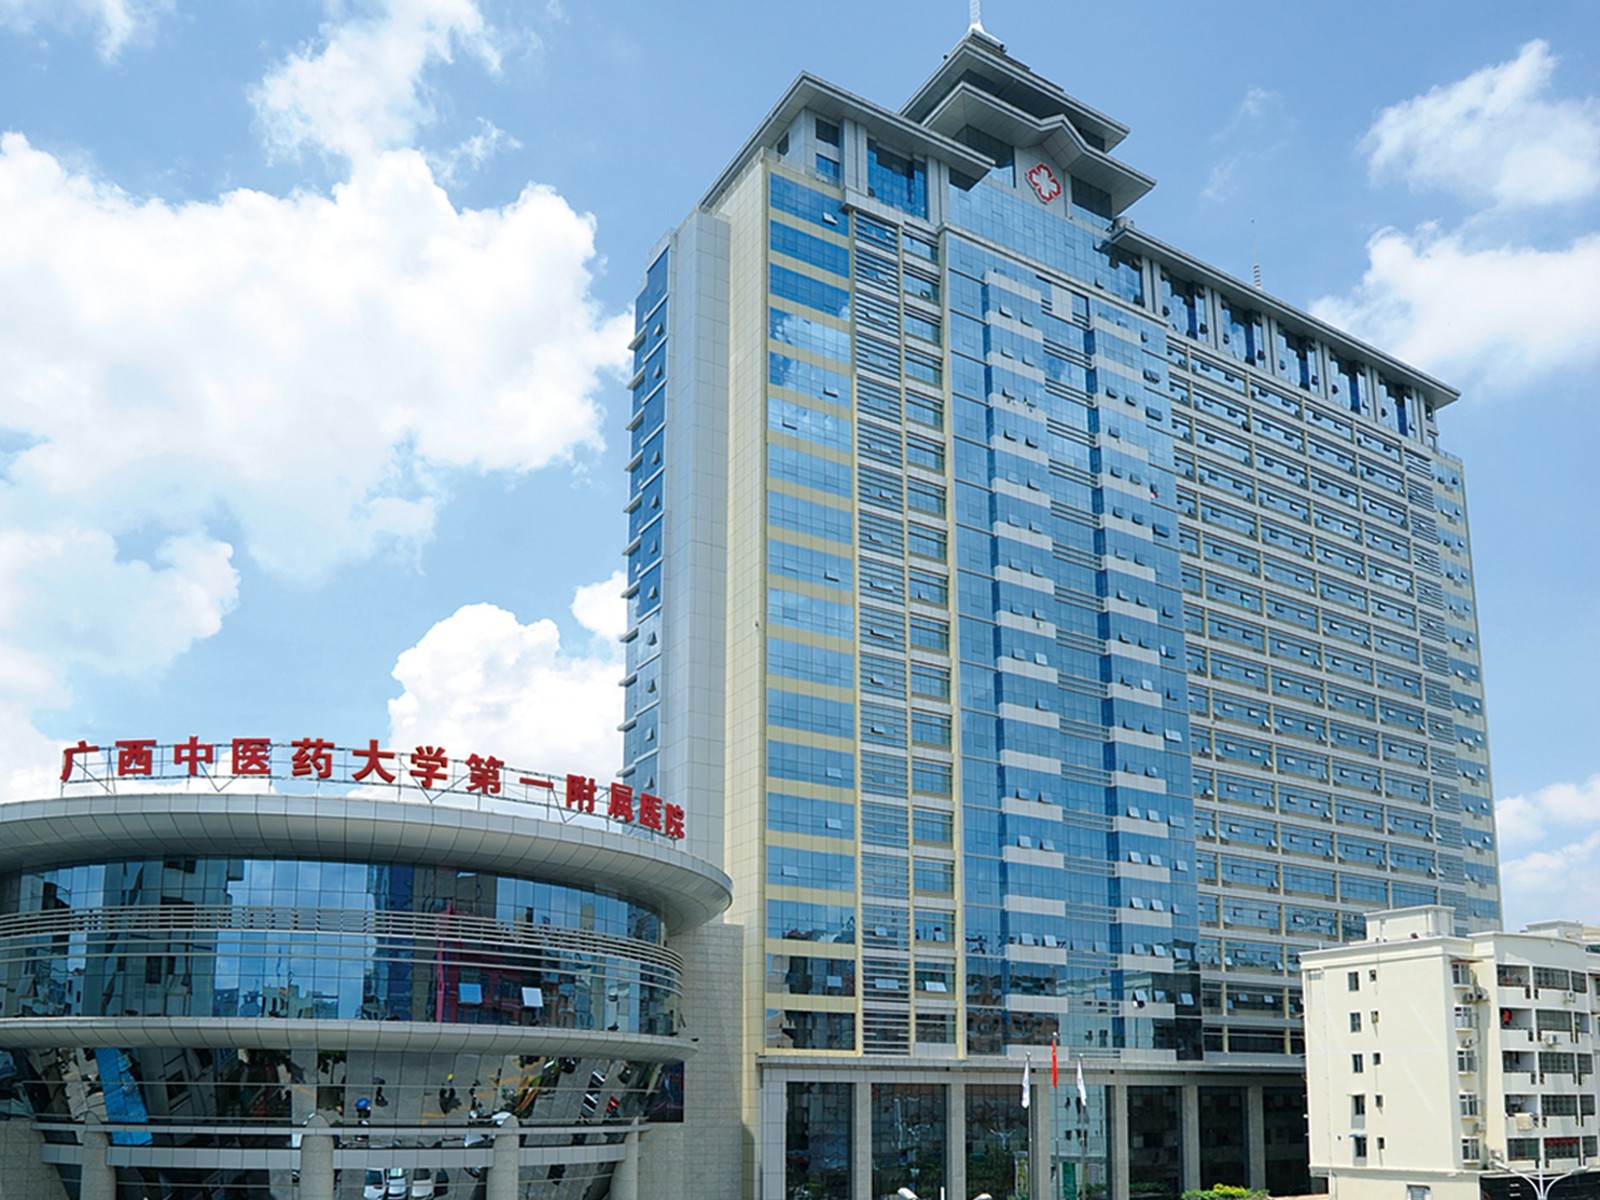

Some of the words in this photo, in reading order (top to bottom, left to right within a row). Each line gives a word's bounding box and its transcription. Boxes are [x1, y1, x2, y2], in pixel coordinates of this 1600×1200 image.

[60, 736, 686, 839] 广西中医药大学第一附属医院
